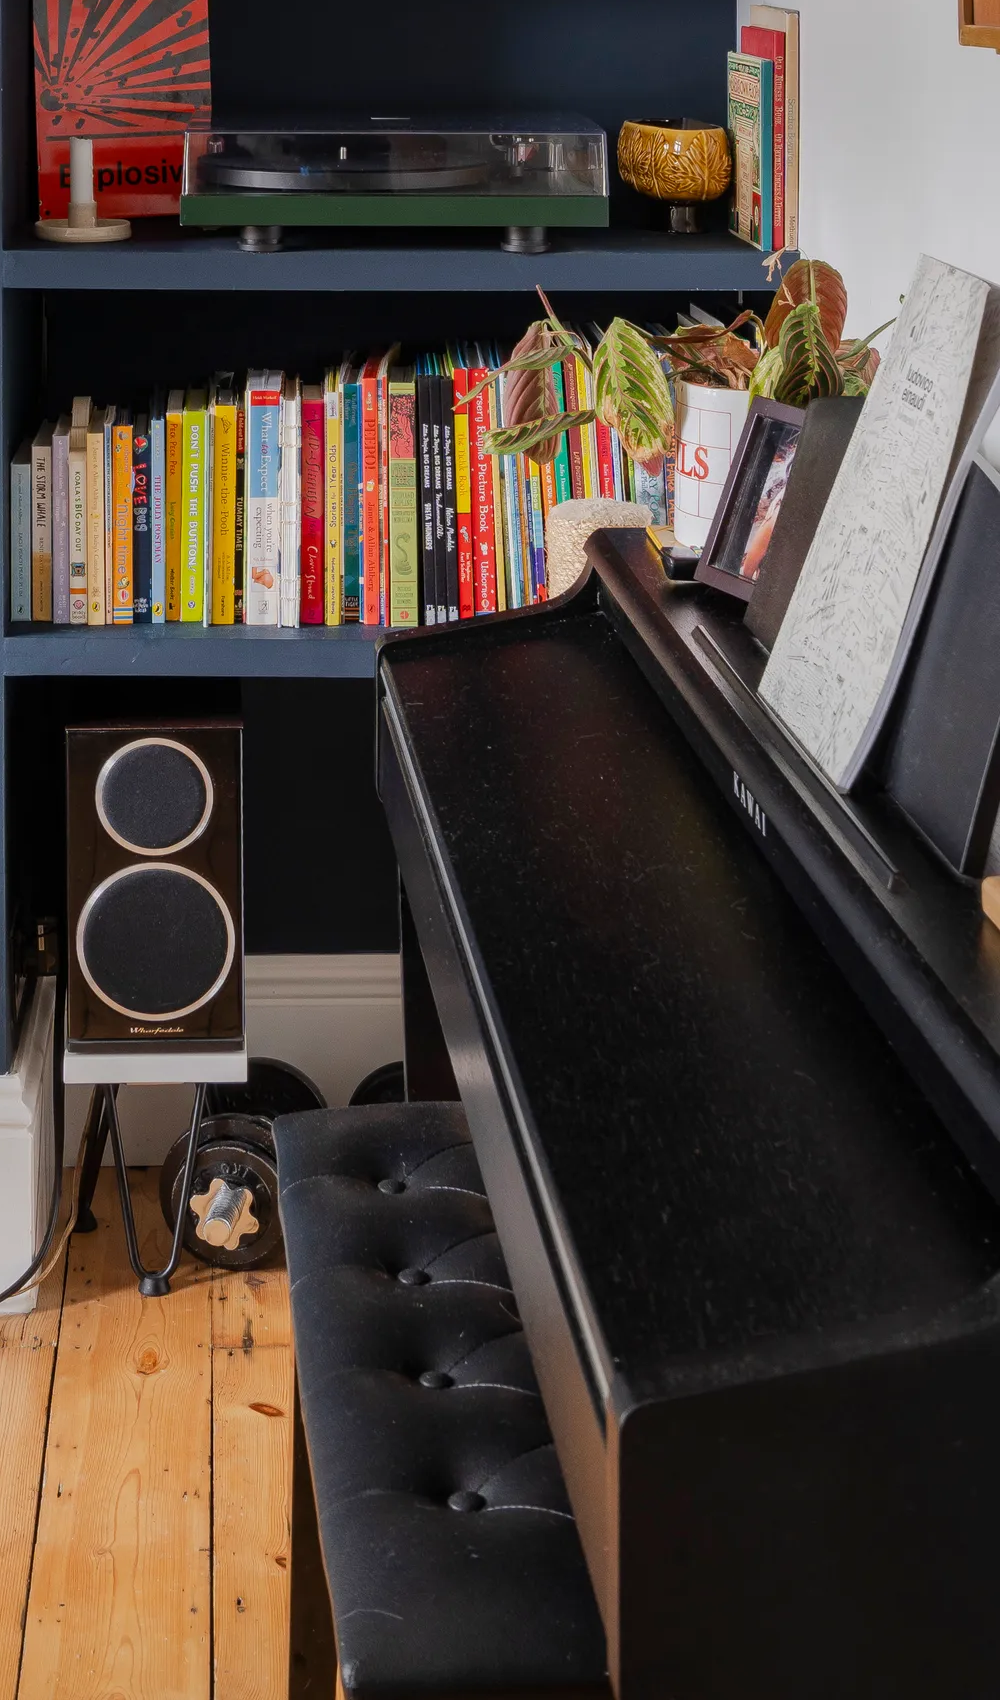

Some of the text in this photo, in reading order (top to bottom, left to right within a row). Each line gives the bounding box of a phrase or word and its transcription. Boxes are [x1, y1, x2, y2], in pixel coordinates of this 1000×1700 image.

[787, 99, 795, 130] Sandra
[60, 159, 184, 192] Eplosiv
[906, 363, 934, 393] ludovico
[901, 384, 925, 412] einaudi
[258, 412, 272, 492] What to Expect
[364, 419, 377, 470] PEEPO!
[36, 457, 46, 527] THE STORM WHALE
[188, 425, 200, 572] DON'T PUSH THE BUTTON!
[74, 504, 83, 519] BIG
[253, 507, 264, 548] expecting
[264, 503, 275, 552] when you're
[367, 502, 375, 522] Janet
[116, 504, 129, 574] night time
[366, 555, 376, 591] Ahlberg
[480, 561, 489, 598] Usborne
[733, 770, 766, 837] KAWAI
[130, 1027, 184, 1035] Wharfedale
